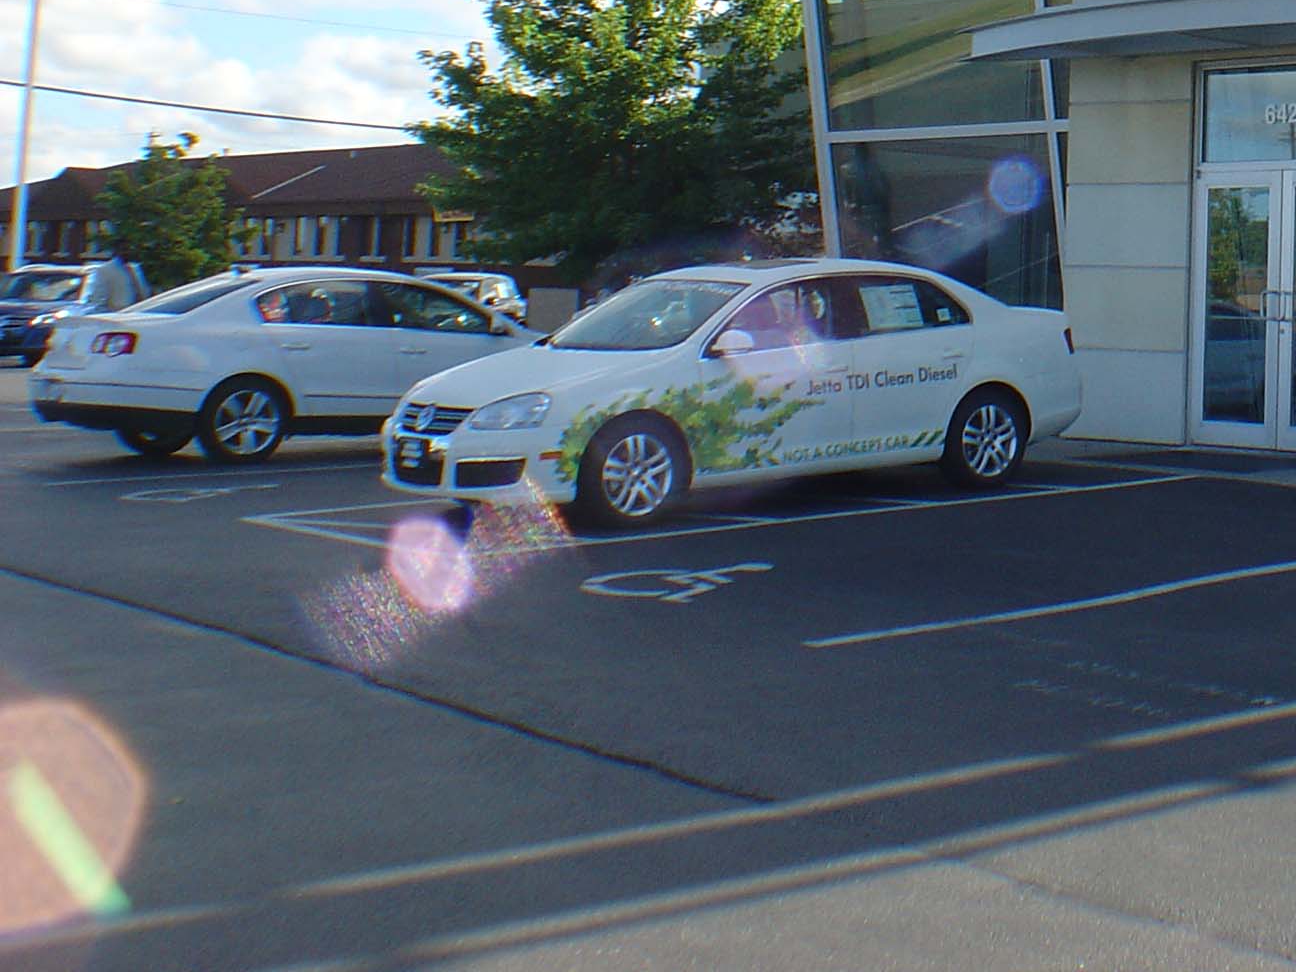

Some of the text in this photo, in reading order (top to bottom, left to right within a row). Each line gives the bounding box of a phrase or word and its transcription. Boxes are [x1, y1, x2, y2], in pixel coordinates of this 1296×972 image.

[807, 363, 957, 395] Jetta TDI Clean Diesel
[784, 435, 909, 461] NOT A CONCEPT CAR
